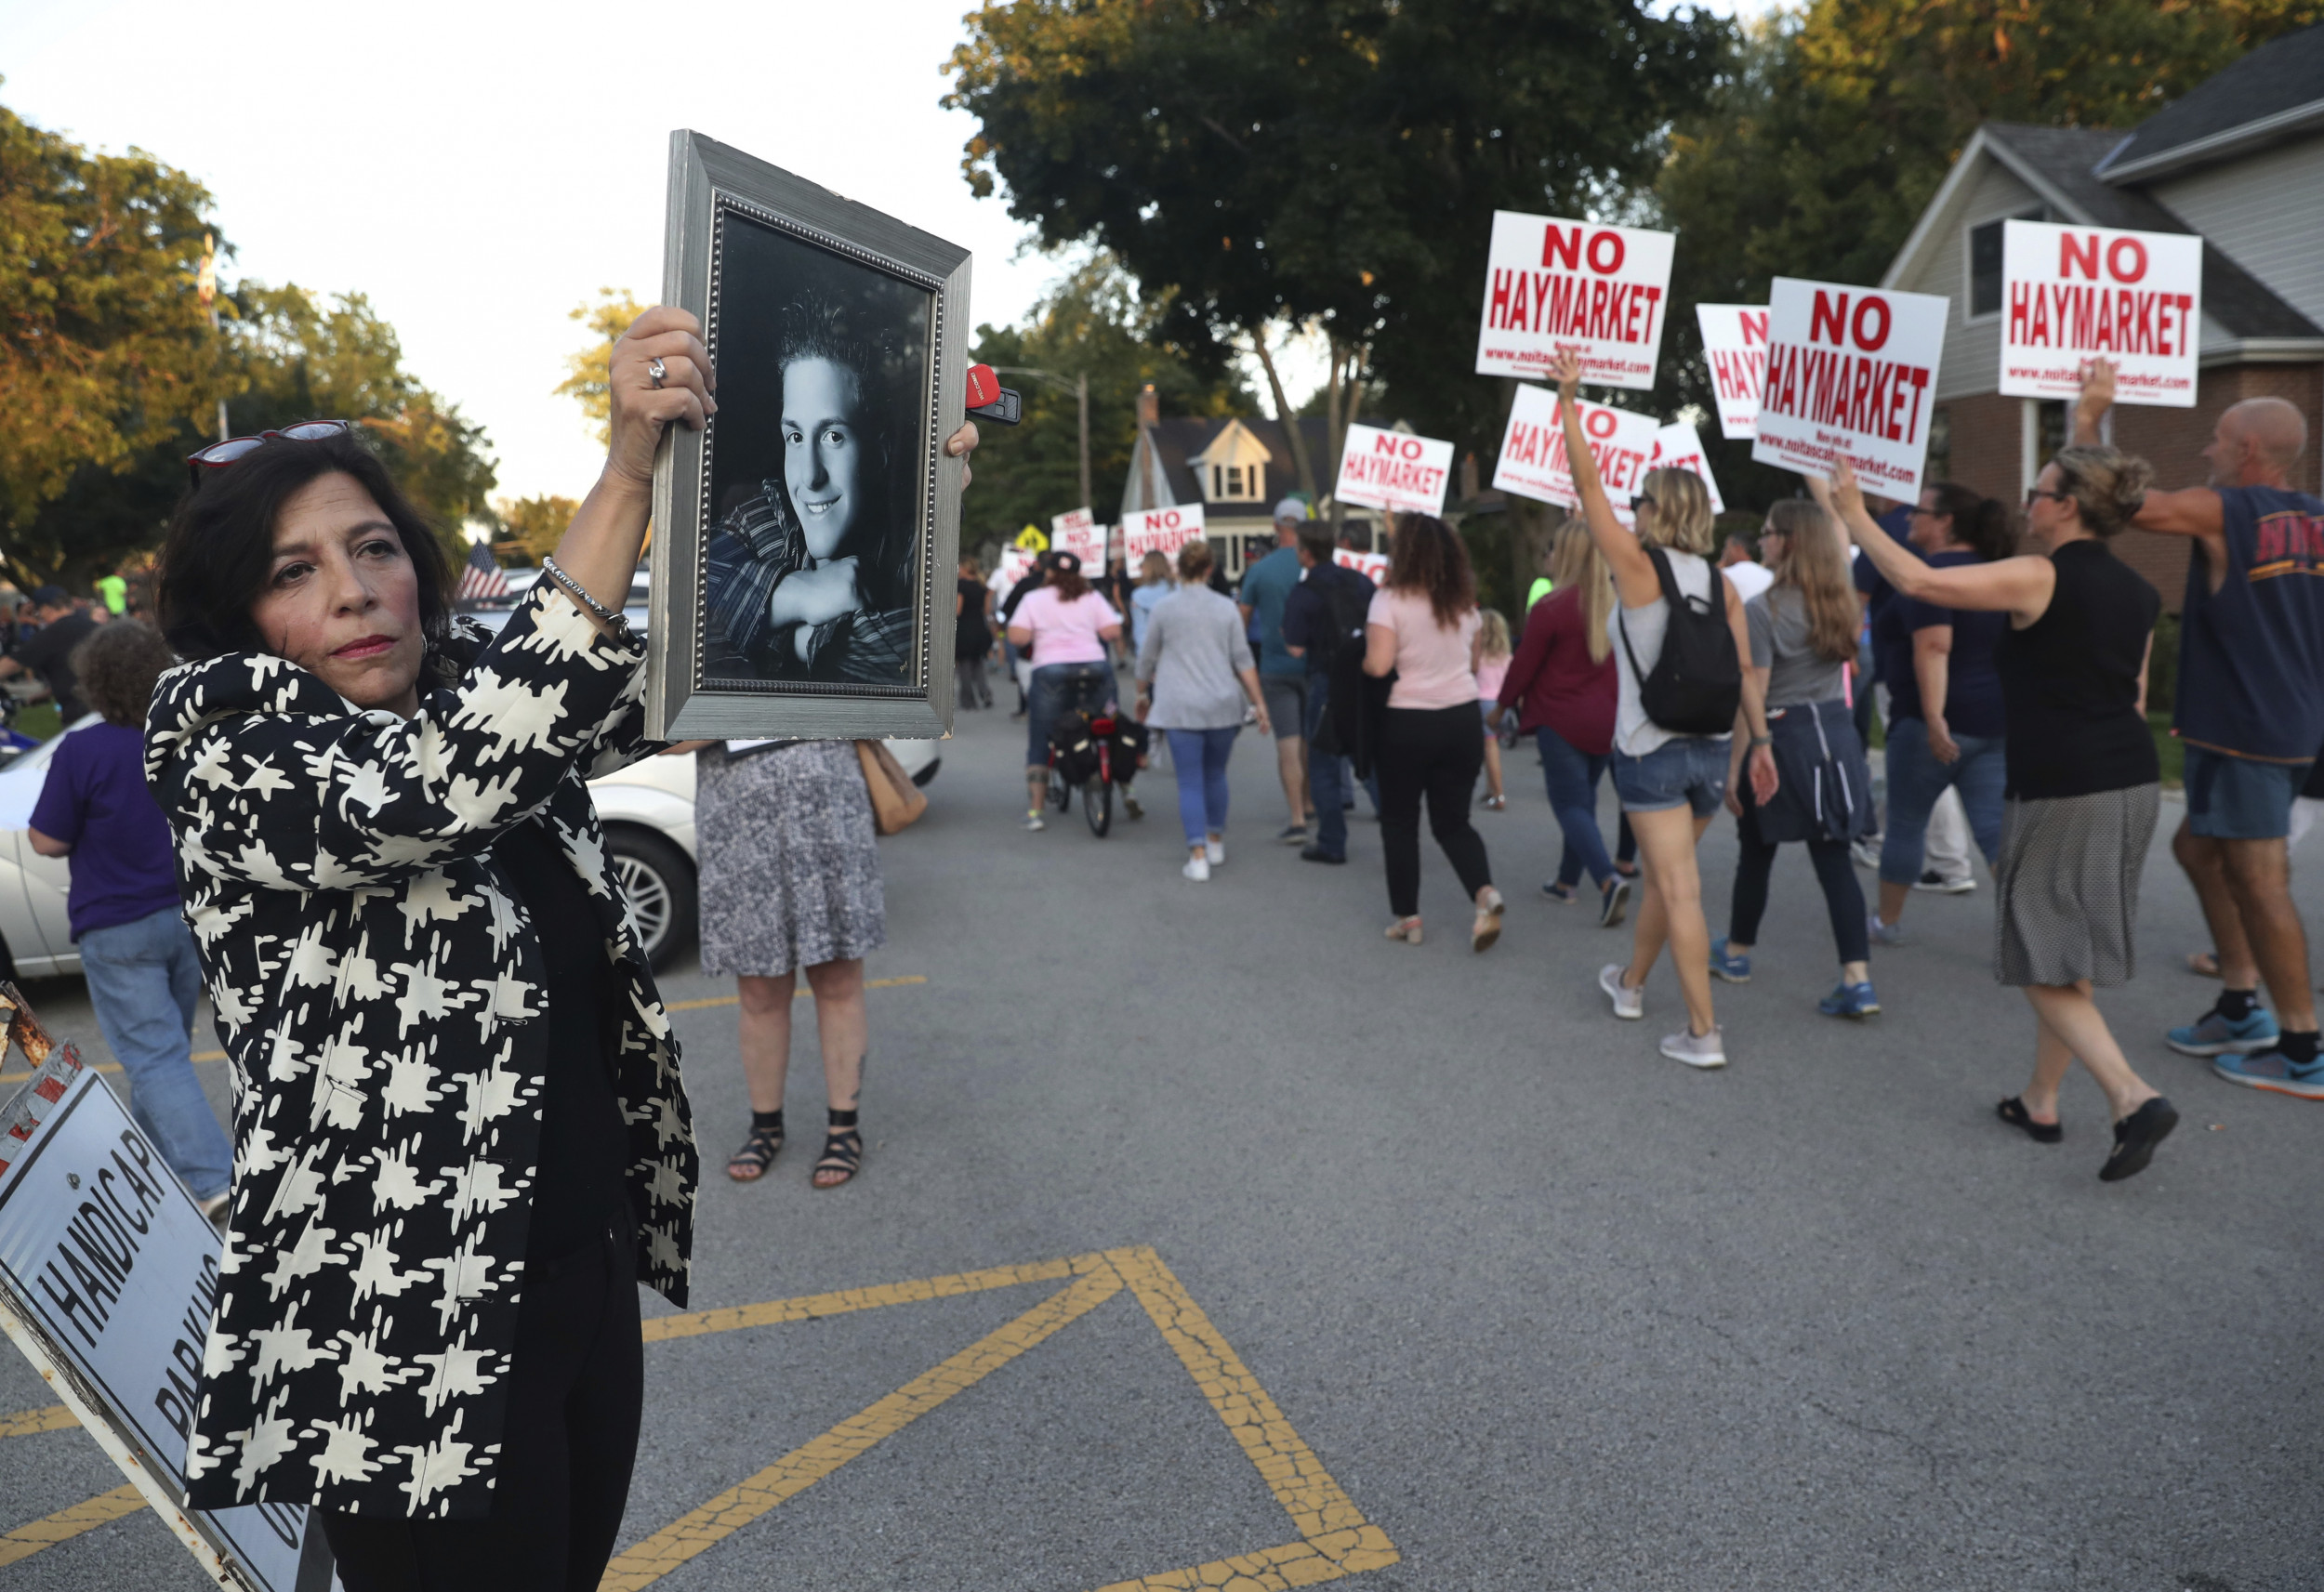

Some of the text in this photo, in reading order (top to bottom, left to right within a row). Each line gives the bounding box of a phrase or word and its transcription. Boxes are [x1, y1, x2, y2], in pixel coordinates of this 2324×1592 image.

[1541, 224, 1625, 275] NO
[2060, 232, 2148, 283] NO
[1489, 268, 1661, 345] HAYMARKET
[1738, 310, 1769, 346] N
[1809, 289, 1892, 352] NO
[2010, 281, 2192, 356] HAYMARKET
[1763, 342, 1930, 445] HAYMARKET
[1343, 453, 1444, 497] HAYMARKET
[1375, 434, 1422, 460] NO
[1506, 421, 1644, 491] HAYMRKET
[1145, 510, 1181, 531] NO
[37, 1128, 165, 1349] HANDICAP
